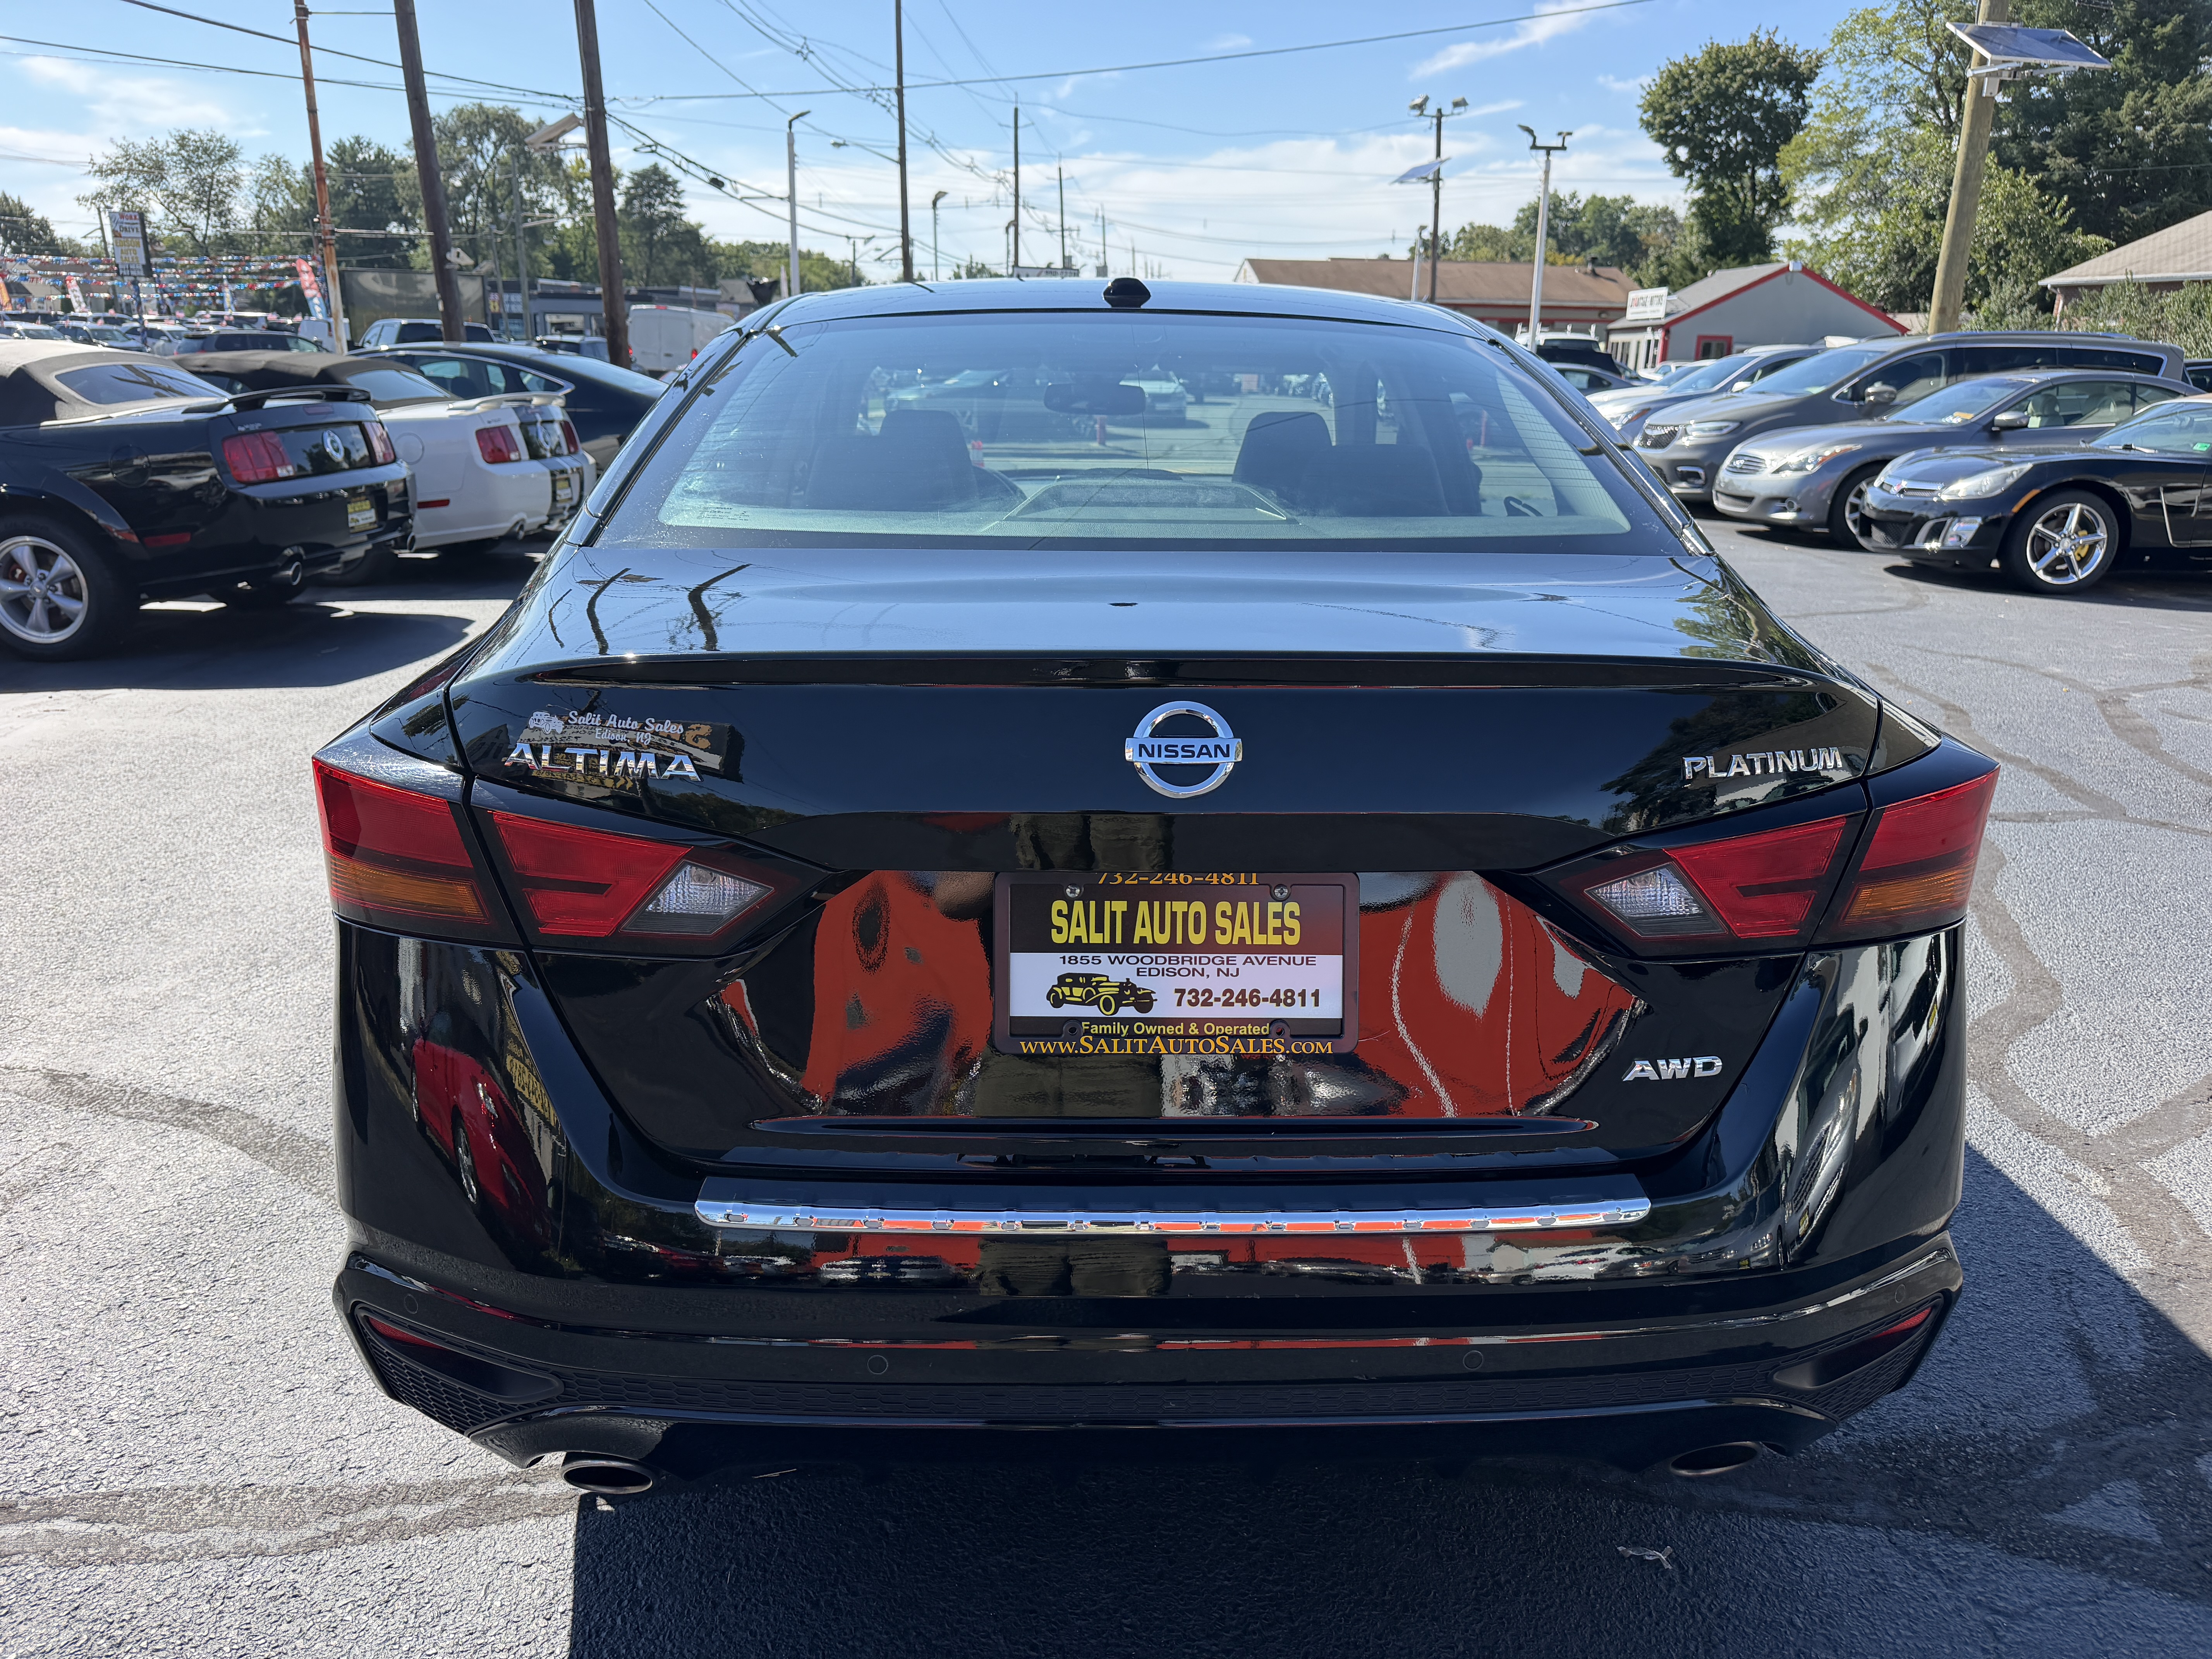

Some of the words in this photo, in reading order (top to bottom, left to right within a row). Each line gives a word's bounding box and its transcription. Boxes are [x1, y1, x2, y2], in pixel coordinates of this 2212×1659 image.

[568, 711, 601, 726] Salit
[606, 714, 639, 730] Auto
[644, 718, 684, 734] Sales
[595, 728, 630, 743] Edison,
[636, 732, 651, 745] NJ
[1139, 744, 1230, 758] NISSAN
[504, 743, 704, 781] ALTIMA
[1682, 747, 1843, 780] PLATINUM
[1051, 900, 1127, 944] SALIT
[1133, 901, 1206, 945] AUTO
[1215, 901, 1300, 945] SALES
[1059, 955, 1102, 965] 1855
[1108, 955, 1237, 965] WOODBRIDGE
[1242, 956, 1317, 966] AVENUE
[1136, 967, 1210, 979] EDISON,
[1216, 968, 1240, 977] NJ
[1174, 988, 1320, 1007] 732-246-4811
[1082, 1022, 1129, 1037] Family
[1133, 1022, 1184, 1034] Owned
[1188, 1023, 1199, 1034] &
[1204, 1023, 1269, 1035] Operated
[1623, 1056, 1722, 1081] AWD
